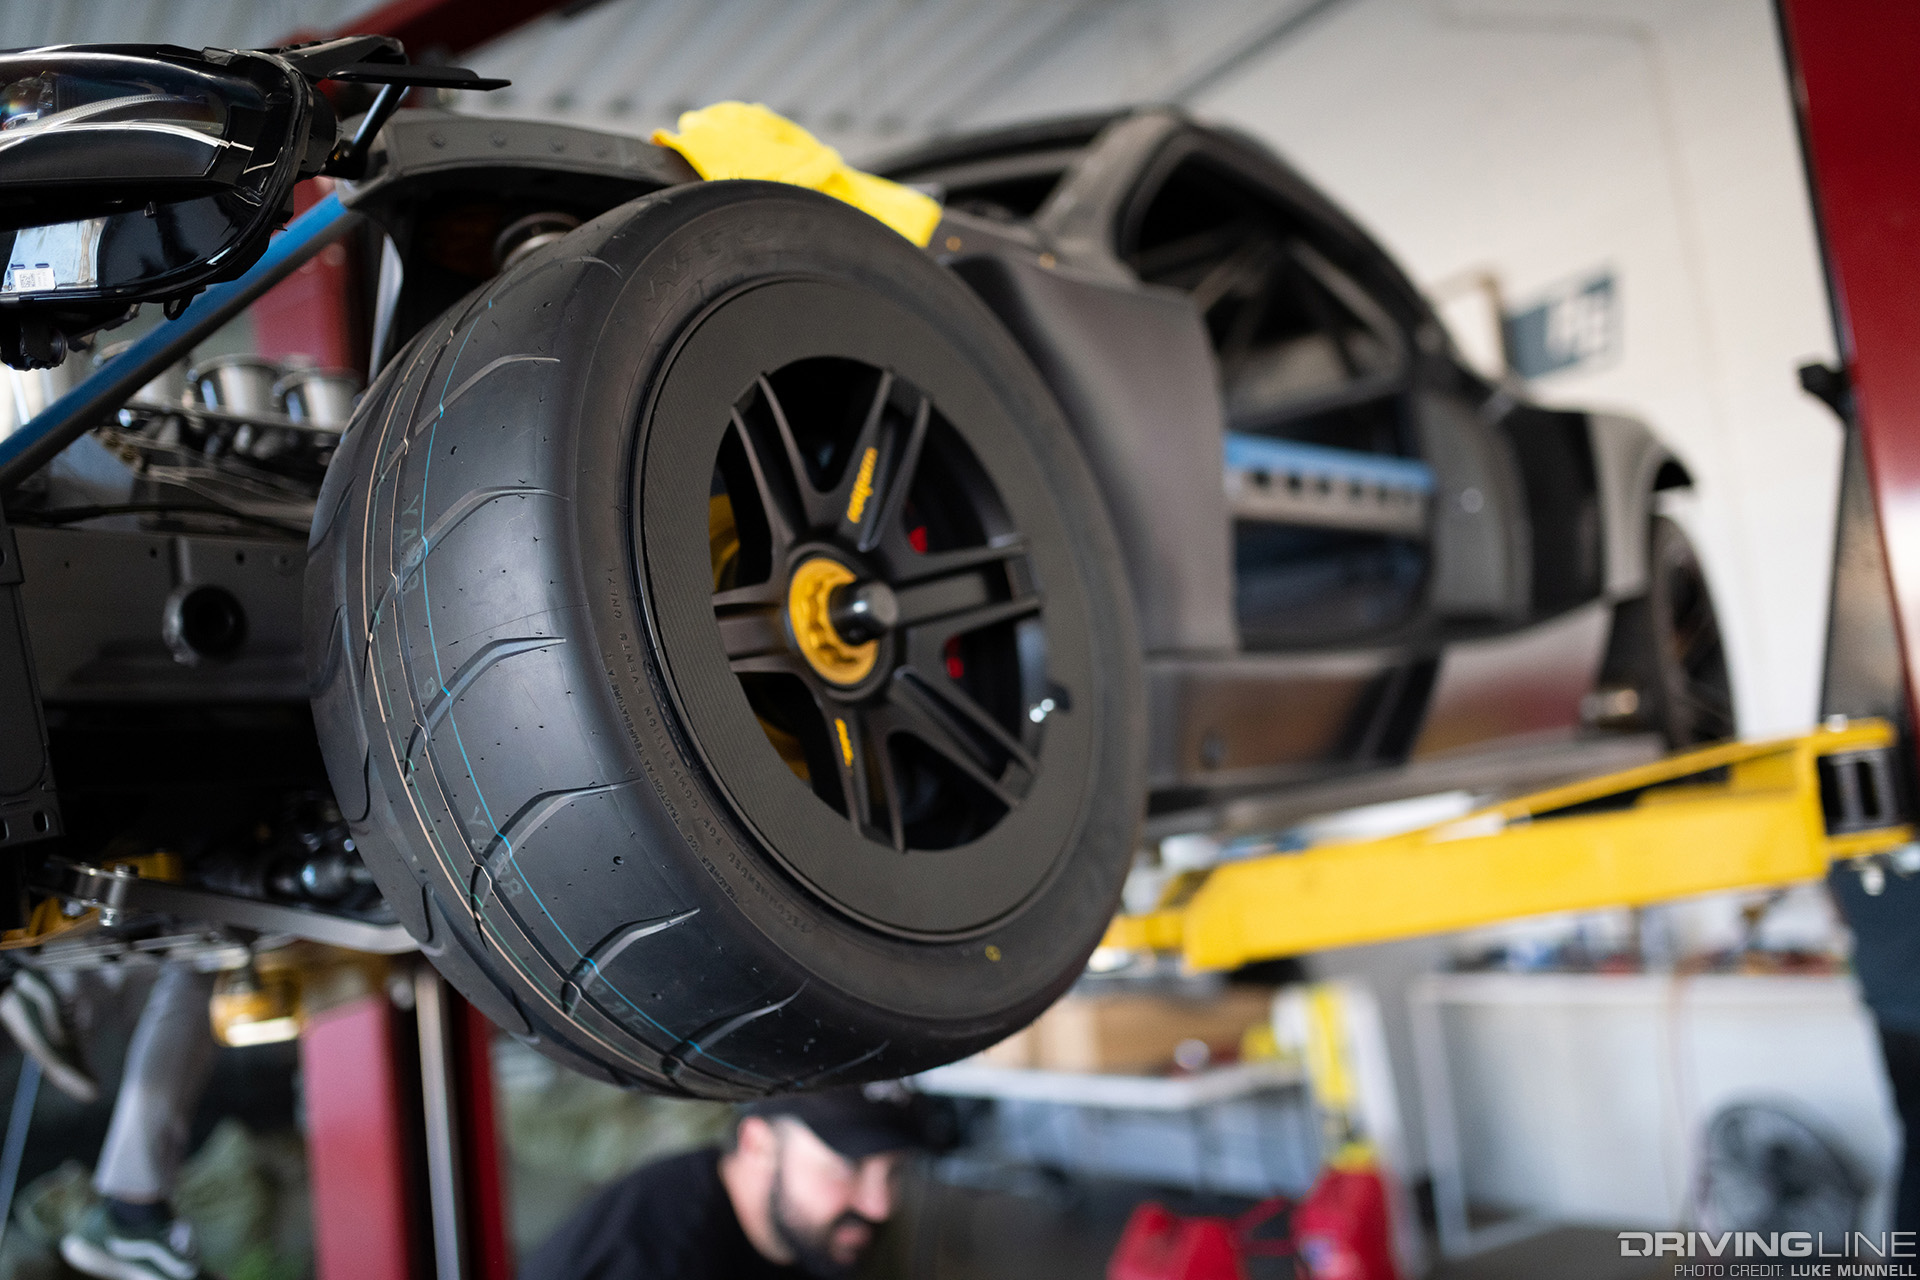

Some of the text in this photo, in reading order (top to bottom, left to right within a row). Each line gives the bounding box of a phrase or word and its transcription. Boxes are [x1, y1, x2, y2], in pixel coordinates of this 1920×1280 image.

[619, 633, 644, 695] EVENTS
[611, 683, 646, 756] TEMPERATURE
[643, 759, 655, 774] AA
[652, 778, 681, 825] TRACTION
[687, 834, 700, 852] 100
[703, 819, 721, 845] FOR
